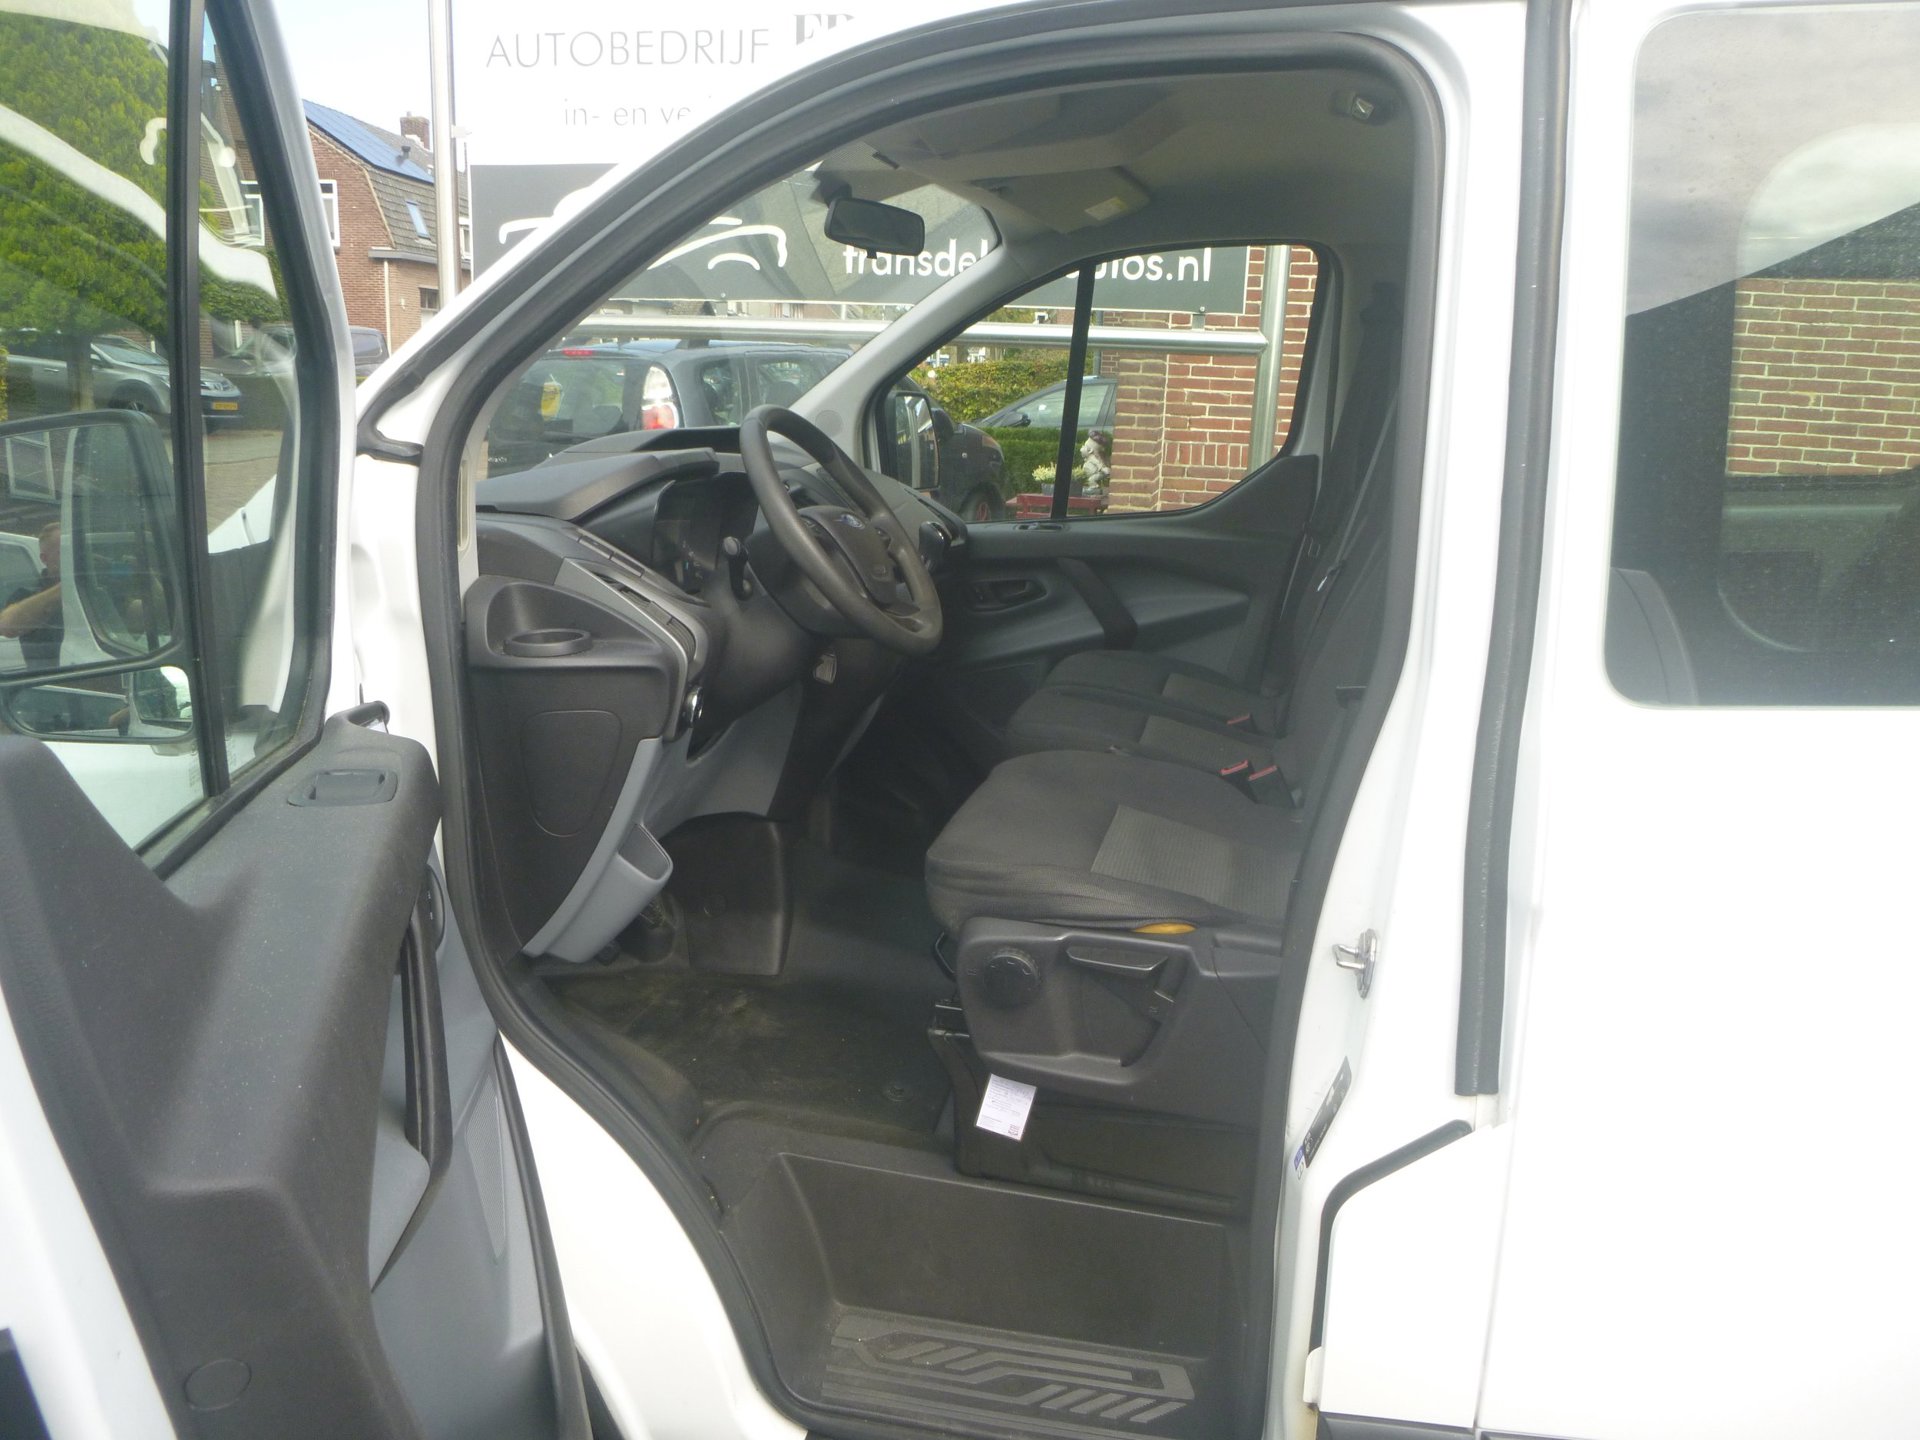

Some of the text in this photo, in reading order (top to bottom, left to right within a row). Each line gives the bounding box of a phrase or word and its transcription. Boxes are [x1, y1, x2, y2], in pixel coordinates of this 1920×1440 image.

[485, 28, 769, 68] AUTOBEDRIJF
[563, 97, 600, 126] in-
[613, 106, 648, 126] en
